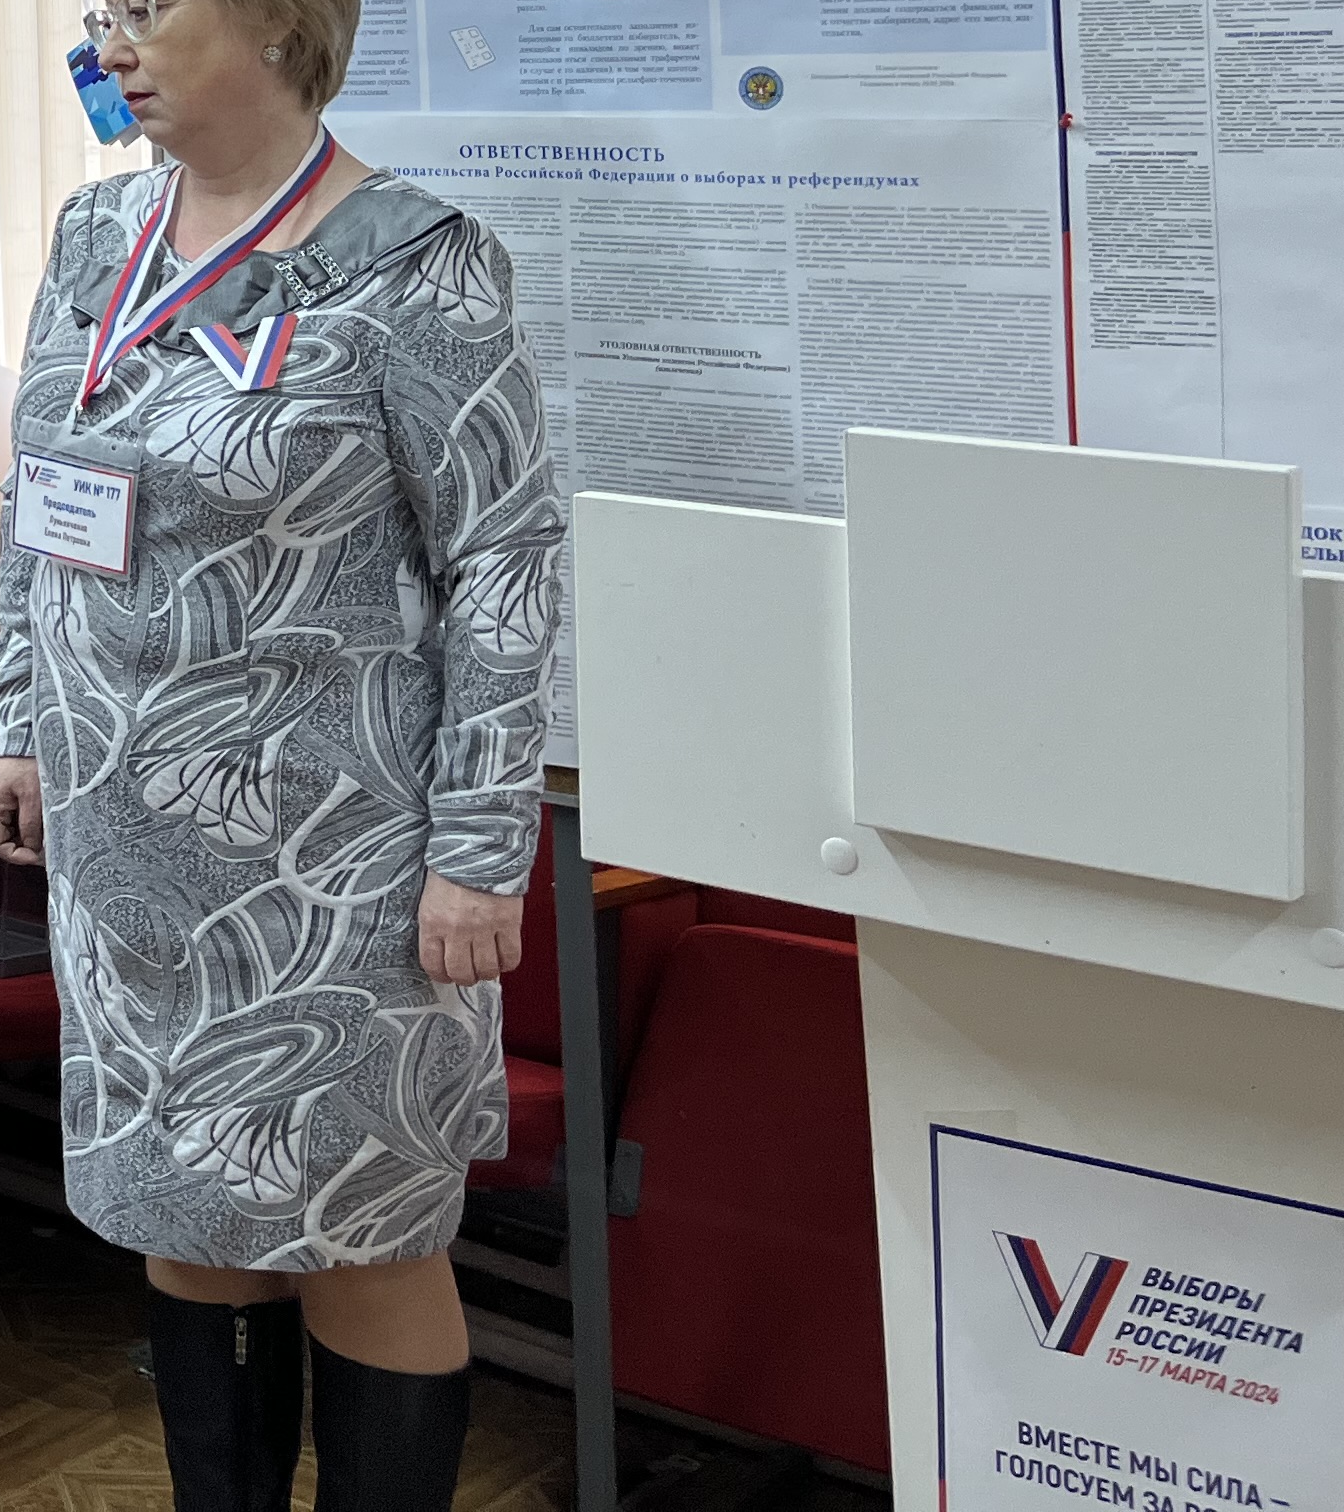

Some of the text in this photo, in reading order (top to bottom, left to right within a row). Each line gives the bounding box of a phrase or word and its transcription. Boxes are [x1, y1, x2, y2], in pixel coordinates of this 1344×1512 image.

[459, 144, 664, 162] ОТВЕТСТВЕННОСТЬ
[495, 165, 583, 180] Российской
[588, 168, 674, 184] Федерации
[680, 173, 689, 182] о
[694, 170, 765, 188] выборах
[771, 175, 781, 185] и
[788, 172, 918, 189] референдумах
[599, 340, 761, 359] УГОЛОВНАЯ ОТВЕТСТВЕННОСТЬ
[43, 495, 97, 519] Председатель
[74, 478, 92, 496] УИК
[106, 486, 121, 502] 177
[1142, 1267, 1264, 1311] ВЫБОРЫ
[1116, 1321, 1225, 1363] РОССИИ
[1129, 1295, 1302, 1352] ПРЕЗИДЕНТА
[1160, 1360, 1227, 1392] МАРТА
[1229, 1378, 1278, 1404] 2024
[996, 1450, 1134, 1508] ГОЛОСУЕМ
[1017, 1421, 1262, 1508] ВМЕСТЕ МЫ СИЛА
